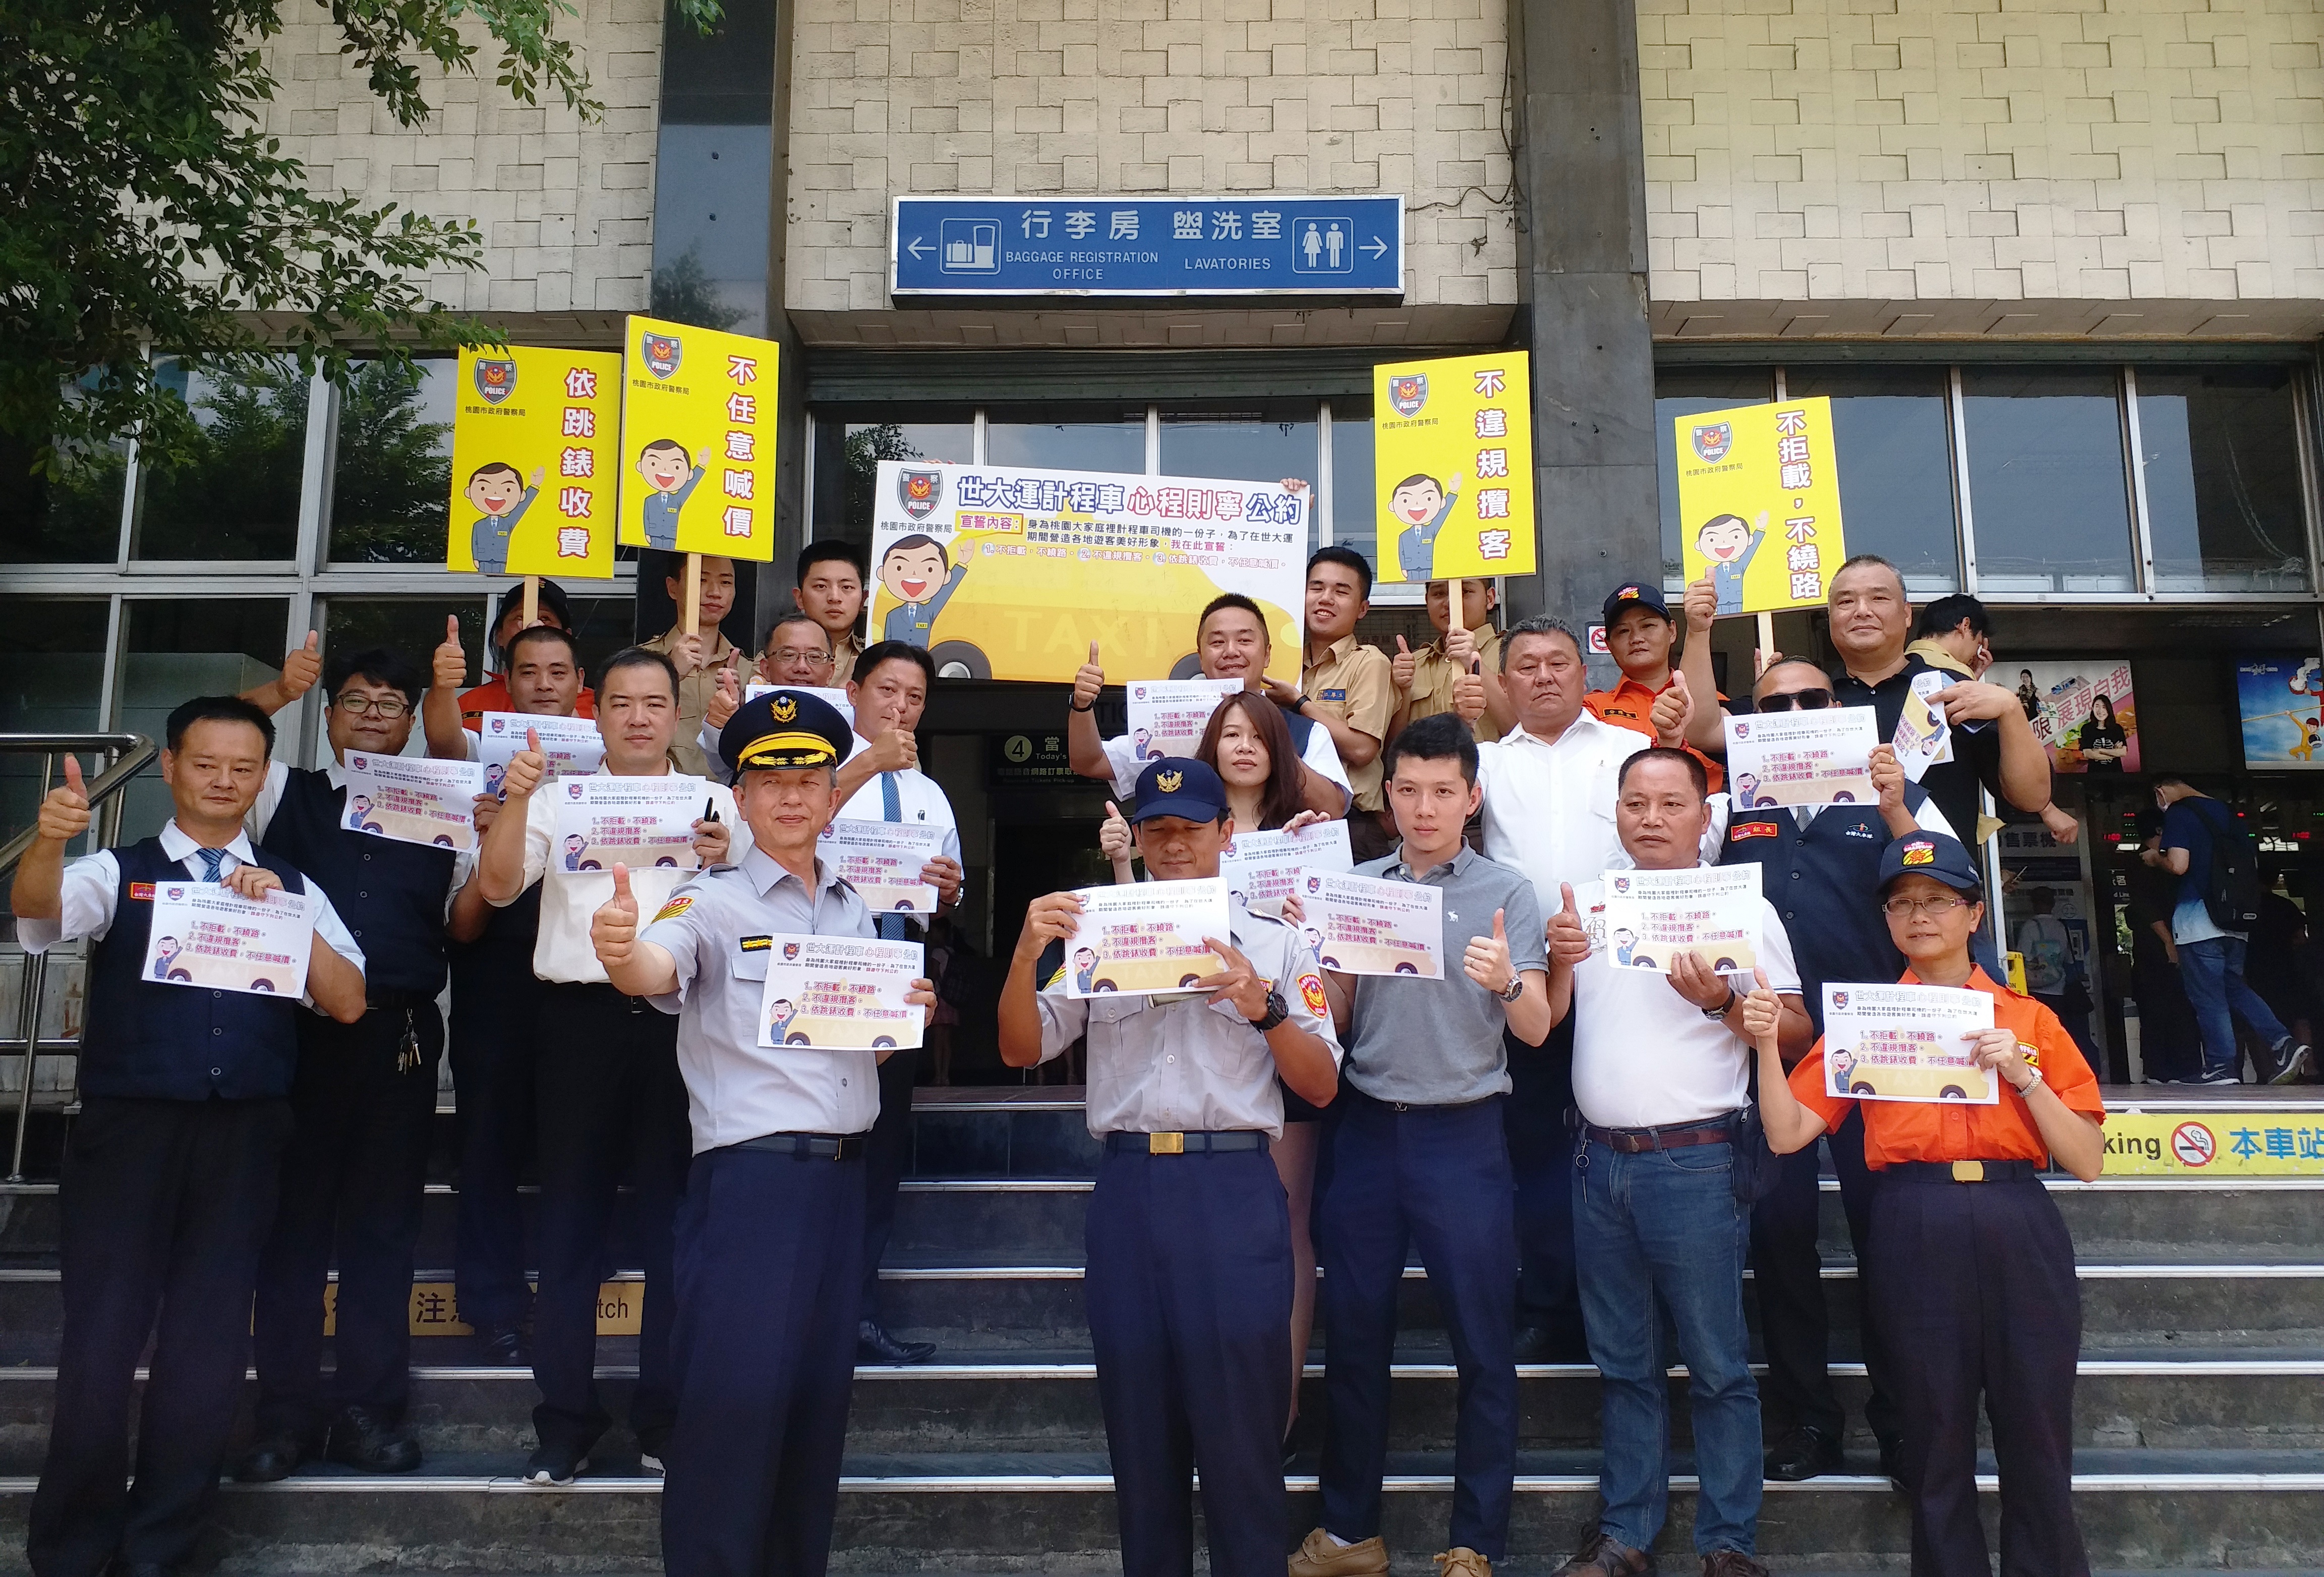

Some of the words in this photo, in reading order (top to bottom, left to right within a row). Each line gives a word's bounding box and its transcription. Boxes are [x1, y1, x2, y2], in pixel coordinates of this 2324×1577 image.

[1021, 210, 1139, 241] 行李房
[1173, 210, 1282, 241] 盥洗室
[1006, 250, 1064, 264] BAGGAGE
[1070, 251, 1158, 264] REGISTRATION
[1184, 257, 1271, 270] LAVATORIES
[1053, 267, 1103, 280] OFFICE
[652, 361, 672, 372] POLICE
[485, 386, 505, 396] POLICE
[632, 378, 689, 396] 桃園市政府警察局
[465, 406, 526, 417] 桃園市政府警察局
[1399, 401, 1419, 410] POLICE
[1382, 418, 1438, 430] 桃園市政府警察局
[722, 355, 757, 538] 不任意喊價
[1703, 447, 1724, 456] POLICE
[558, 368, 597, 559] 依跳錶收費
[1475, 369, 1511, 559] 不違規攬客
[1686, 463, 1743, 477] 桃園市政府警察局
[908, 501, 931, 511] POLICE
[1776, 409, 1822, 599] 不拒載，不繞路
[881, 521, 952, 533] 桃園市政府警察局
[1004, 610, 1158, 658] TAXI
[1012, 740, 1025, 758] 4
[1044, 737, 1060, 752] 當
[2103, 1132, 2162, 1160] king
[2229, 1127, 2324, 1160] 本車站
[597, 1298, 628, 1319] tch
